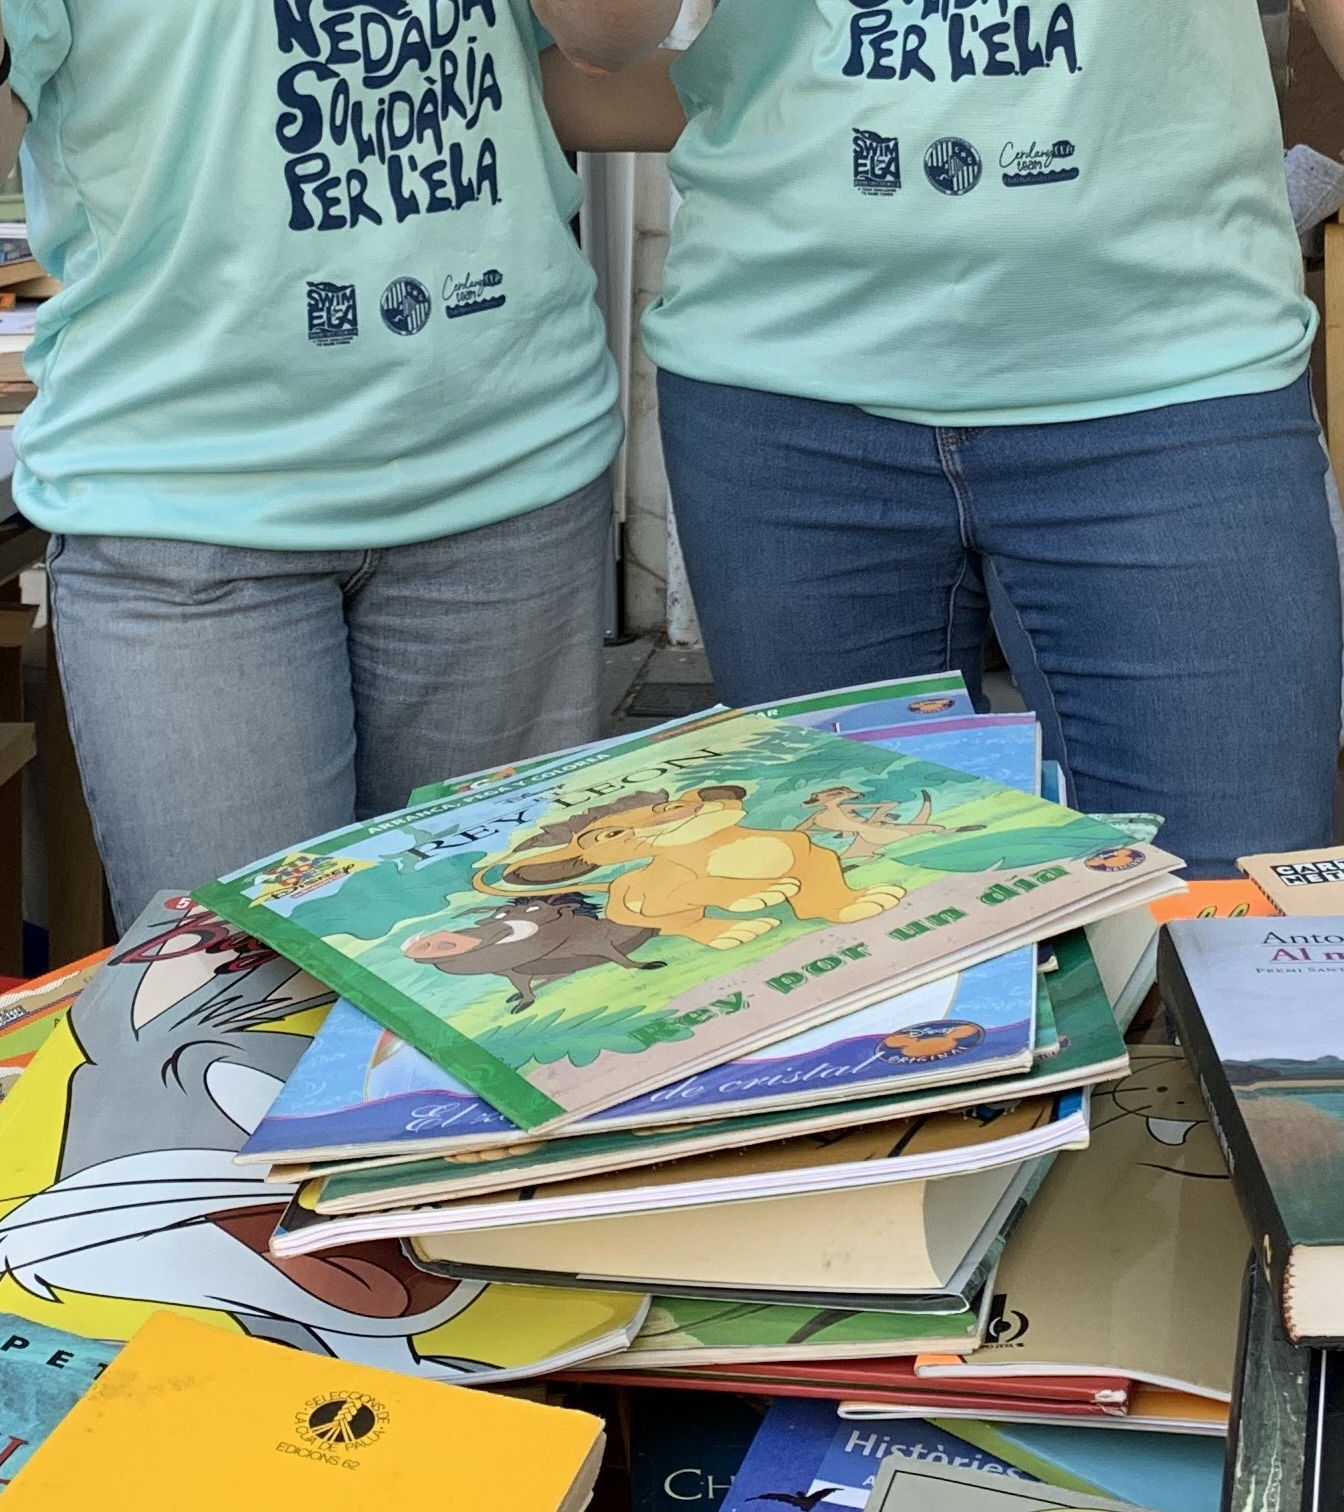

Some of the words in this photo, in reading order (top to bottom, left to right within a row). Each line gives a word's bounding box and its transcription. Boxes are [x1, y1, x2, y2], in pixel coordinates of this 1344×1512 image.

[842, 9, 936, 82] PER
[284, 152, 383, 231] PER
[367, 798, 464, 836] ARRANCA,
[464, 785, 513, 806] PEGA
[531, 752, 610, 782] COLOREA
[410, 810, 529, 862] REY
[175, 897, 192, 910] 5
[629, 990, 752, 1050] Rey
[765, 941, 873, 994] por
[887, 905, 968, 941] un
[975, 864, 1073, 907] día
[1270, 946, 1311, 962] Al
[650, 1073, 704, 1105] de
[718, 1050, 886, 1097] cristal
[304, 1390, 386, 1412] SELECCIONS
[275, 1441, 342, 1467] EDICIONS
[341, 1458, 361, 1471] 62
[844, 1430, 1026, 1485] Històries
